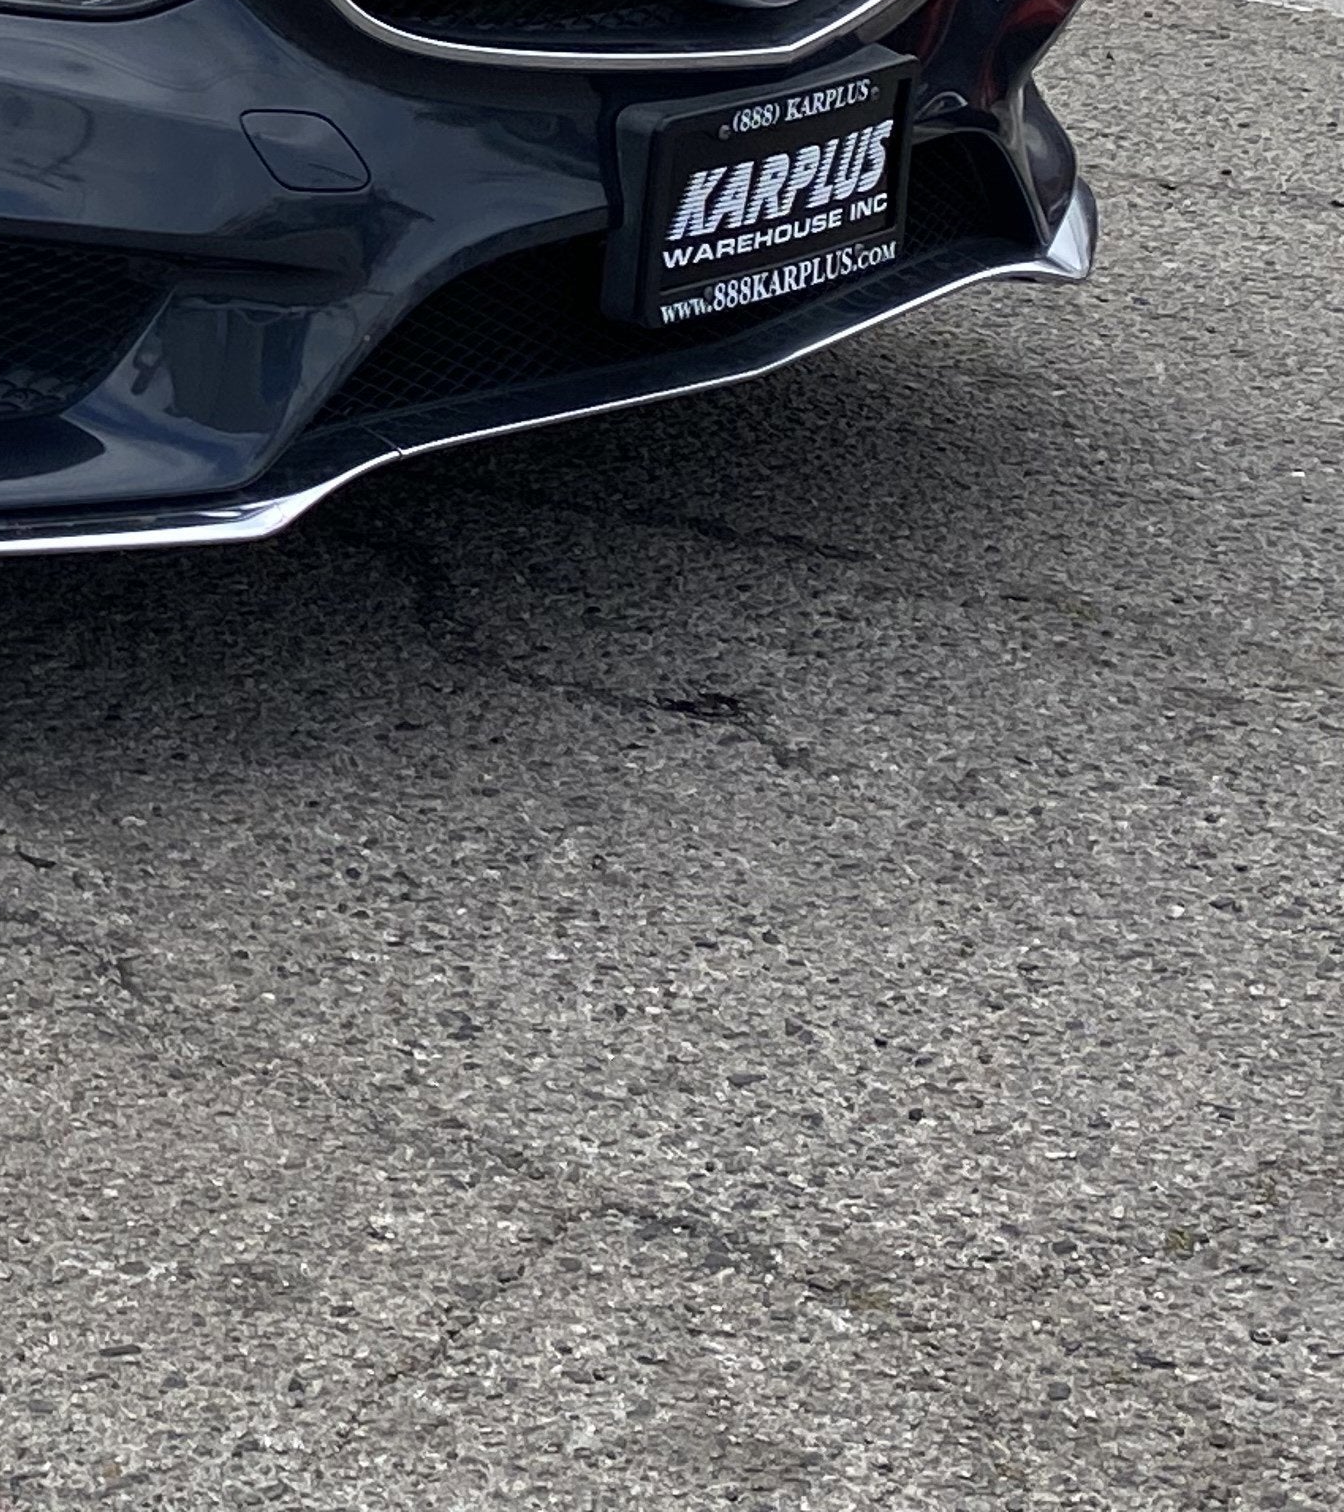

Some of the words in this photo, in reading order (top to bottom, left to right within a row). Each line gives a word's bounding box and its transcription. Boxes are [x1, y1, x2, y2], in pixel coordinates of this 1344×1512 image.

[732, 103, 781, 133] (888)
[784, 78, 872, 122] KARPLUS
[665, 119, 894, 242] KARPLUS
[662, 213, 843, 270] WAREHOUSE
[849, 192, 888, 222] INC
